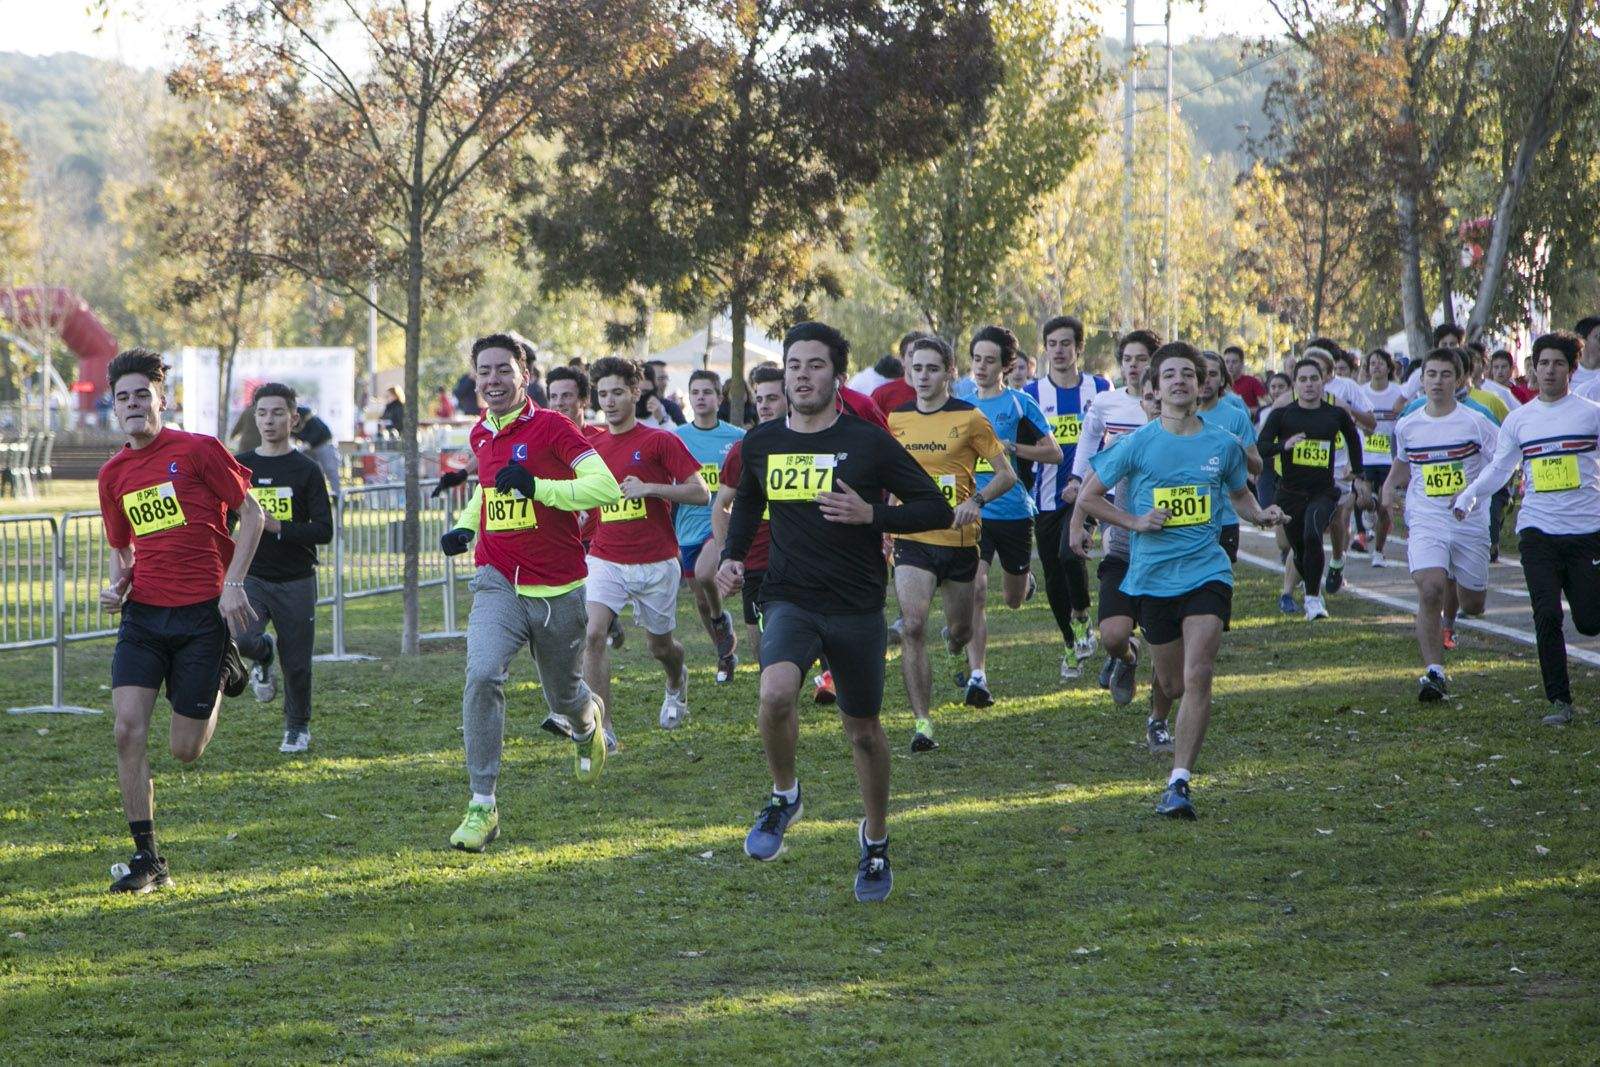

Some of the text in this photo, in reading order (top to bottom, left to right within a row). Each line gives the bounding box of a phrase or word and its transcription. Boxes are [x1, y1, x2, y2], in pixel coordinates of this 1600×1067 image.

[1297, 447, 1328, 461] 1633
[770, 468, 829, 490] 0217
[1426, 471, 1463, 488] 4673
[129, 496, 178, 526] 0889
[488, 498, 528, 521] 0877
